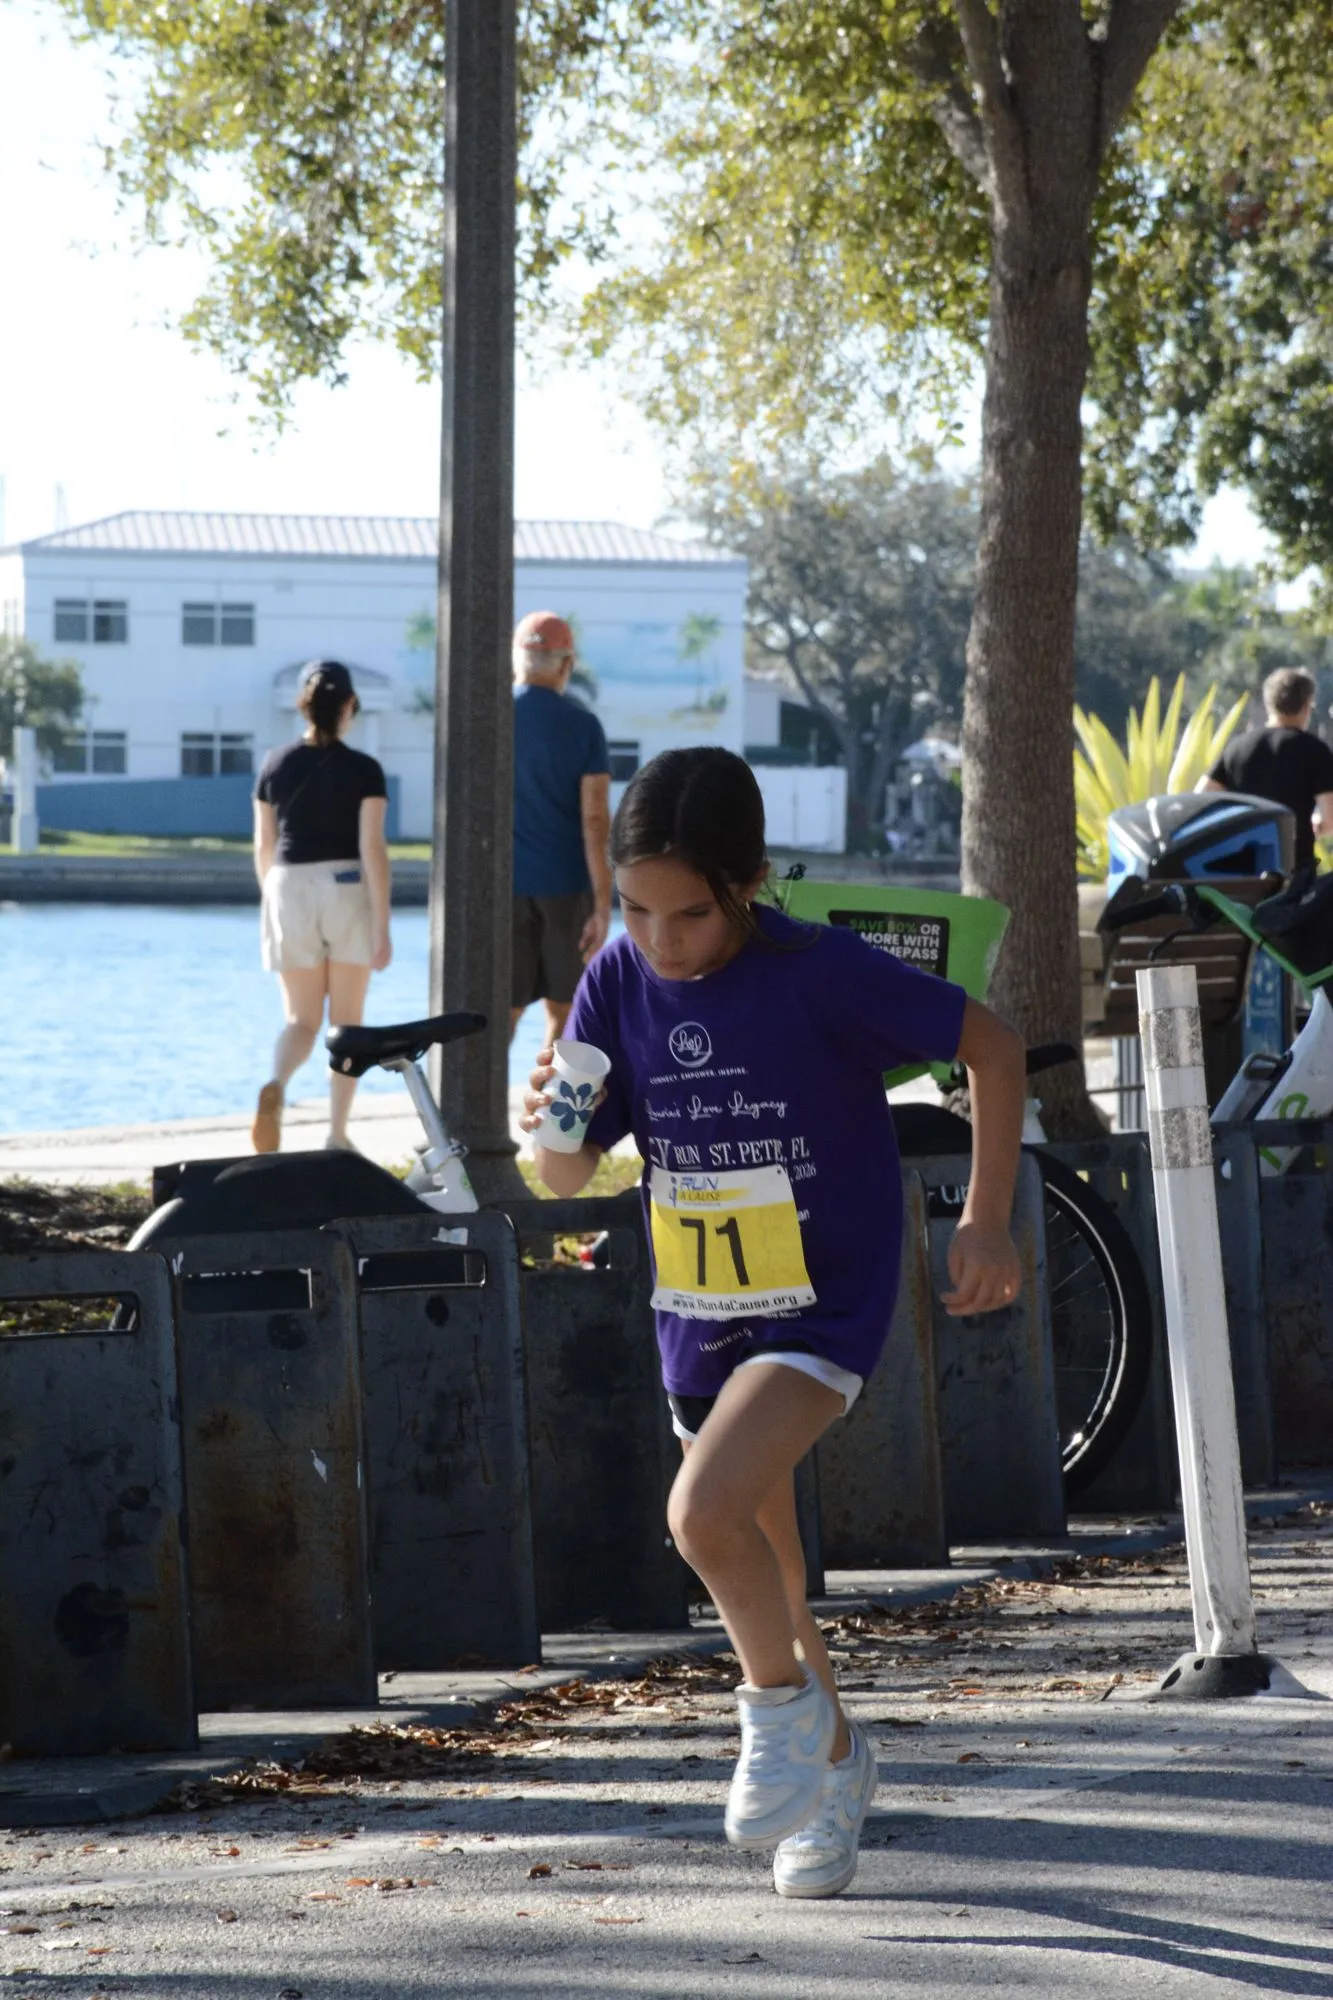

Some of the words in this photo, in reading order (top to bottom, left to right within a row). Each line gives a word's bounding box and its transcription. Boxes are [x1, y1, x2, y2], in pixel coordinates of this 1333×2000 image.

[849, 919, 885, 931] SAVE
[920, 923, 941, 936] OR
[860, 932, 900, 944] MORE
[903, 934, 939, 948] WITH
[872, 945, 939, 960] MEPASS
[680, 1070, 717, 1080] EMPOWER.
[718, 1066, 749, 1077] INSPIRE.
[687, 1094, 723, 1121] Love
[727, 1090, 788, 1119] Legacy
[673, 1144, 701, 1165] RUN
[709, 1142, 736, 1167] ST.
[738, 1138, 788, 1165] PETE,
[791, 1136, 810, 1160] FL
[681, 1176, 720, 1191] RUN
[679, 1216, 751, 1287] 71
